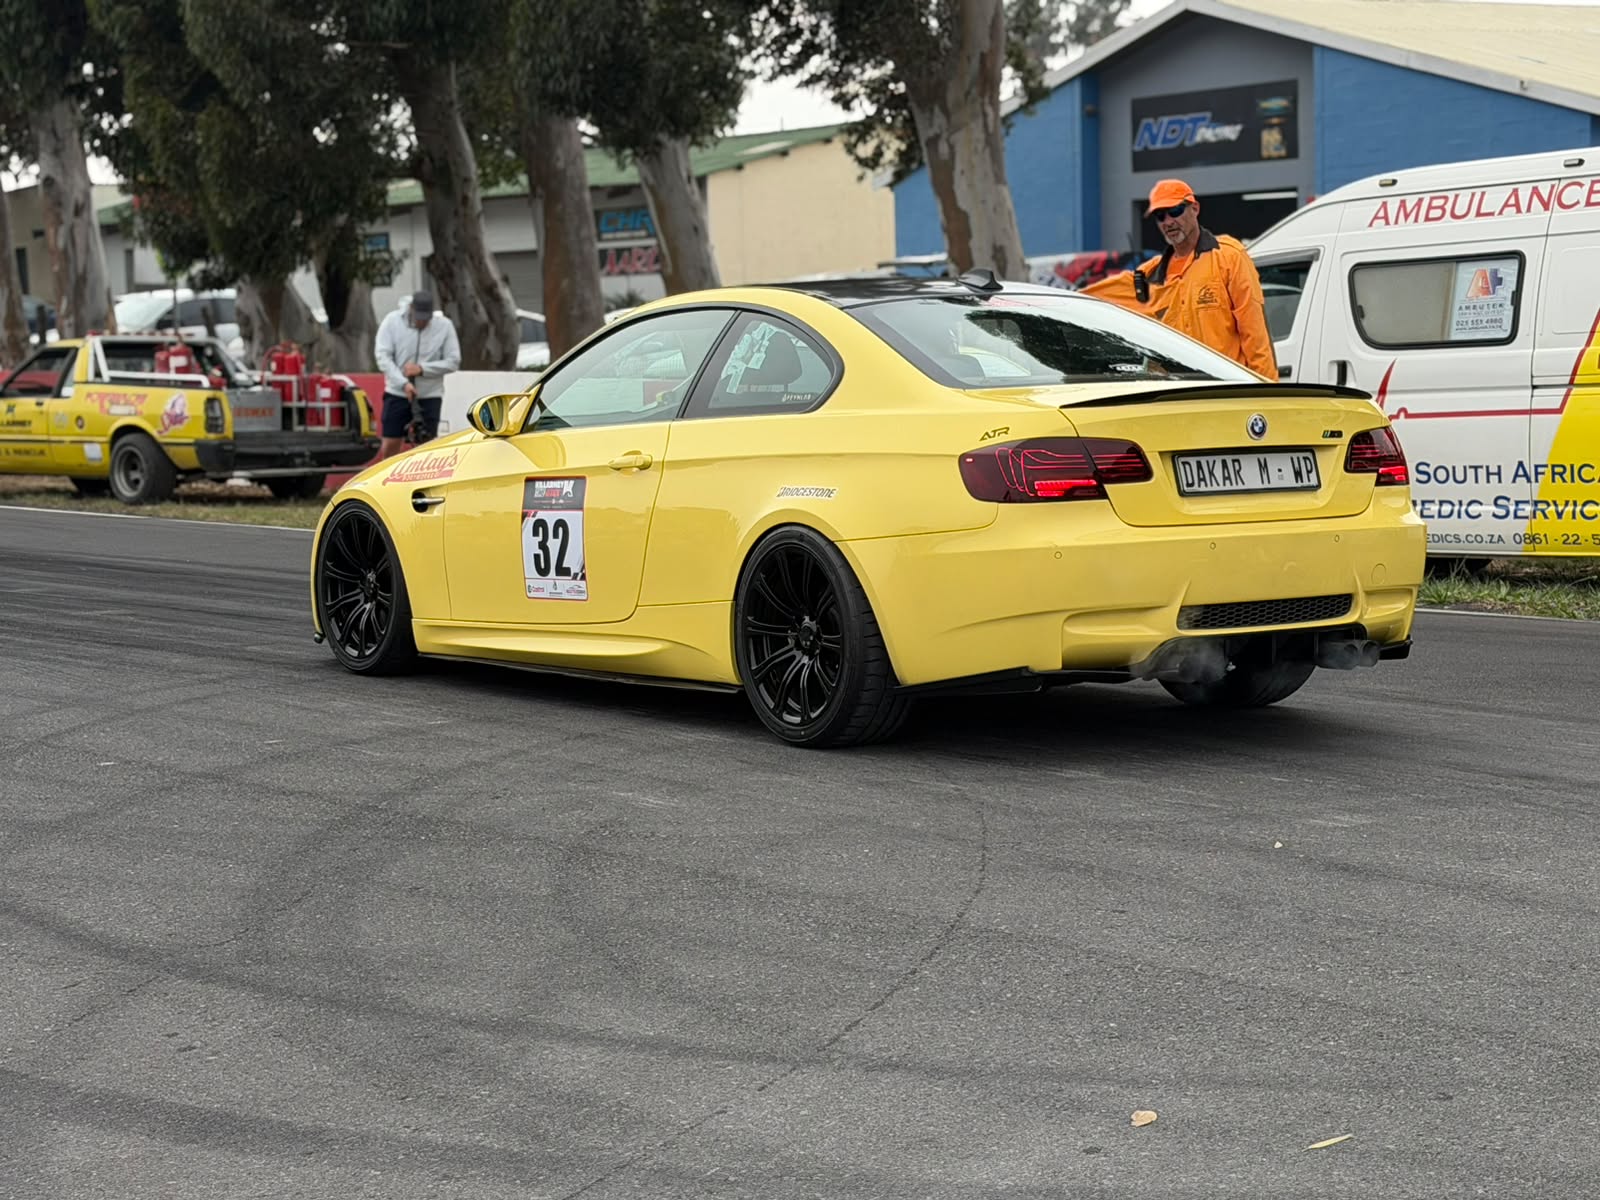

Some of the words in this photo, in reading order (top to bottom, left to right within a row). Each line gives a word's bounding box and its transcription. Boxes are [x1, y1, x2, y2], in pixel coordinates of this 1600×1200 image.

[1135, 111, 1212, 151] NDT
[1367, 179, 1600, 228] AMBULANCE
[979, 426, 1010, 442] ATR
[1181, 458, 1245, 488] DAKAR
[1257, 457, 1271, 485] M
[1290, 455, 1314, 484] WP
[1415, 461, 1503, 484] SOUTH
[1511, 460, 1600, 484] AFRIC
[1411, 499, 1484, 520] EDIC
[532, 518, 572, 577] 32
[1512, 532, 1549, 545] 0861
[1560, 534, 1582, 545] 22
